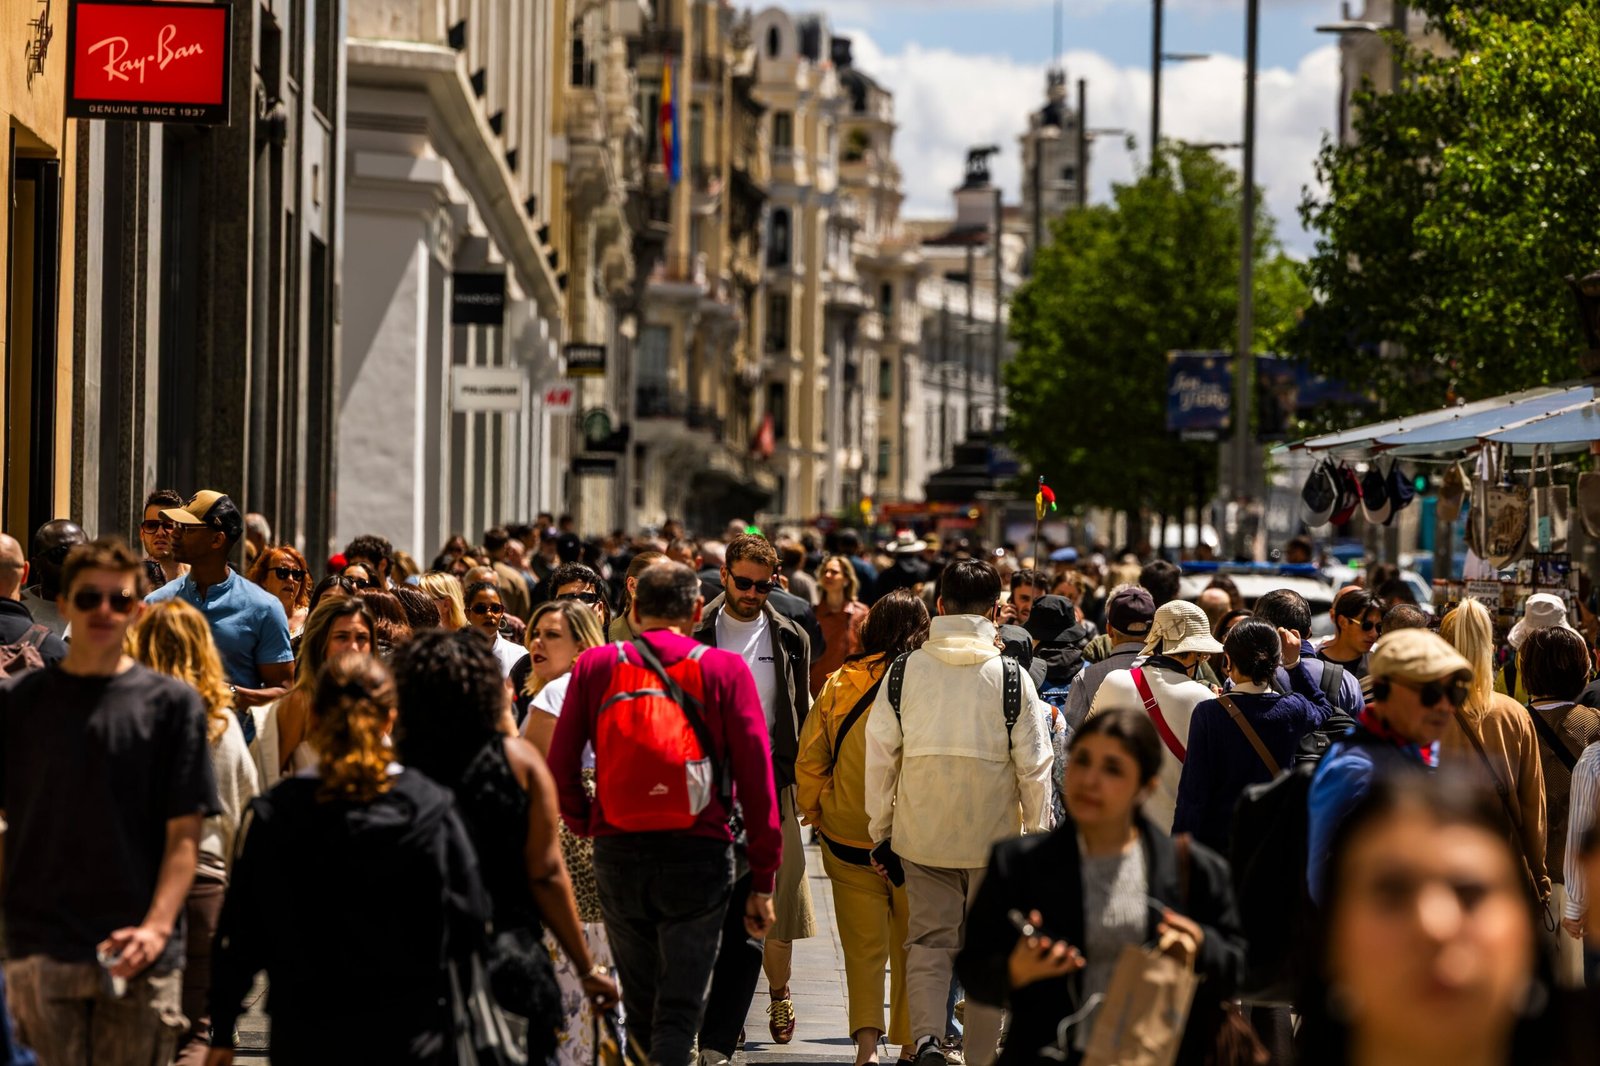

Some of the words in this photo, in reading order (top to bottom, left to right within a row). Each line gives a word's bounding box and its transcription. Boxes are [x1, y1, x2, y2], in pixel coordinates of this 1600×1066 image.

[88, 104, 138, 115] GENUINE
[142, 107, 176, 116] SINCE
[179, 108, 206, 117] 1937
